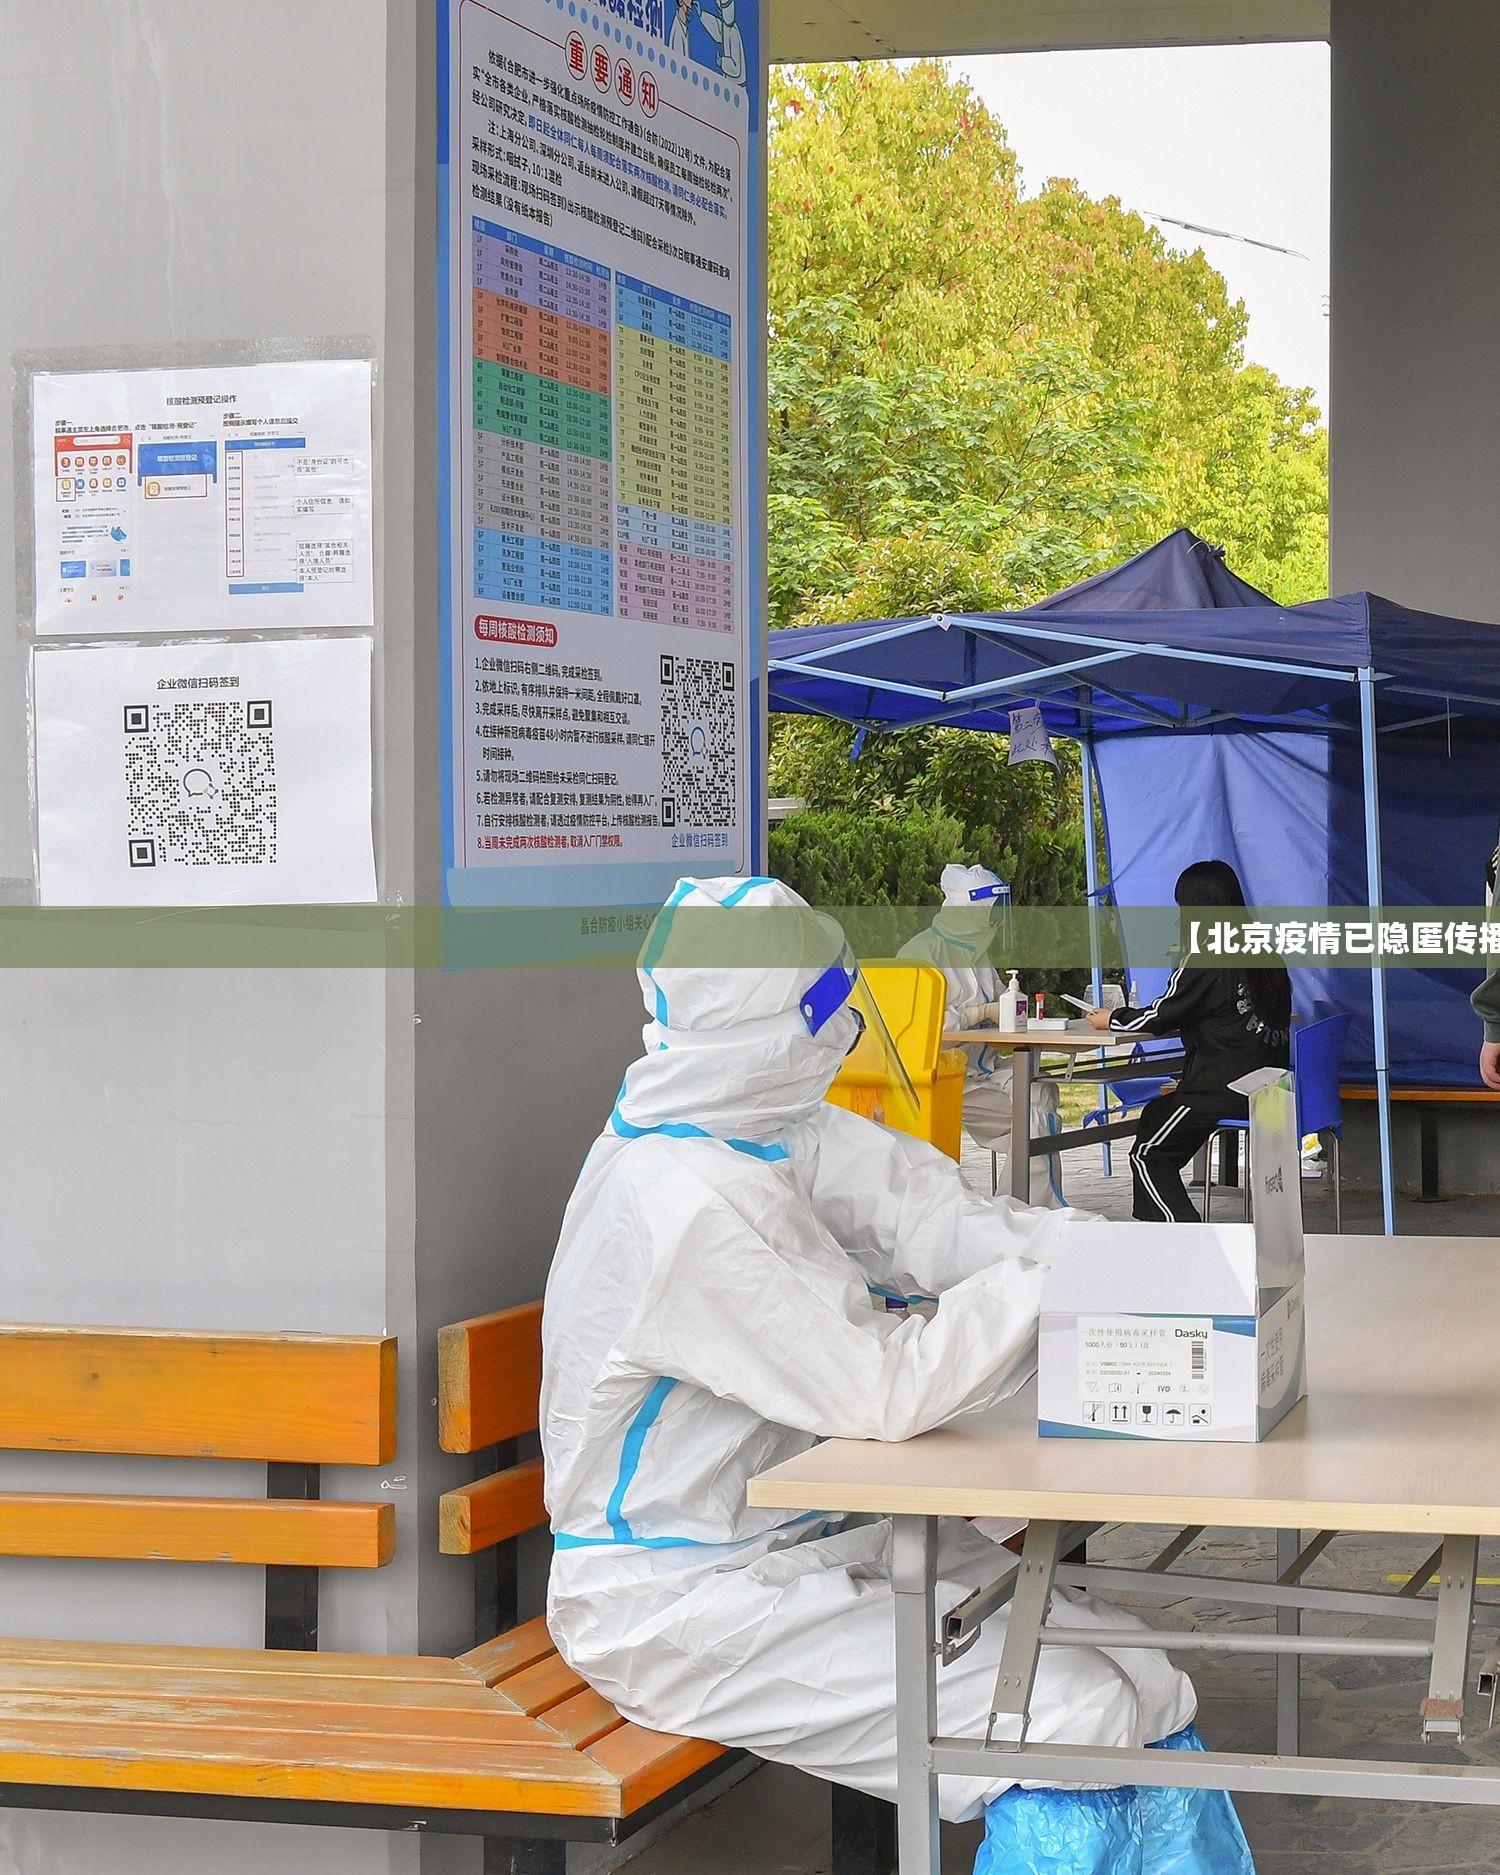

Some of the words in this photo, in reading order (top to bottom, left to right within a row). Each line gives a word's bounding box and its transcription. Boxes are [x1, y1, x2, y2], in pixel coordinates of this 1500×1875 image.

[569, 39, 656, 110] 重要通知
[479, 619, 554, 646] 每周核酸检测须知
[156, 676, 240, 690] 企业微信扫码签到
[1175, 1328, 1208, 1340] Dasky
[1157, 1385, 1171, 1393] IVD
